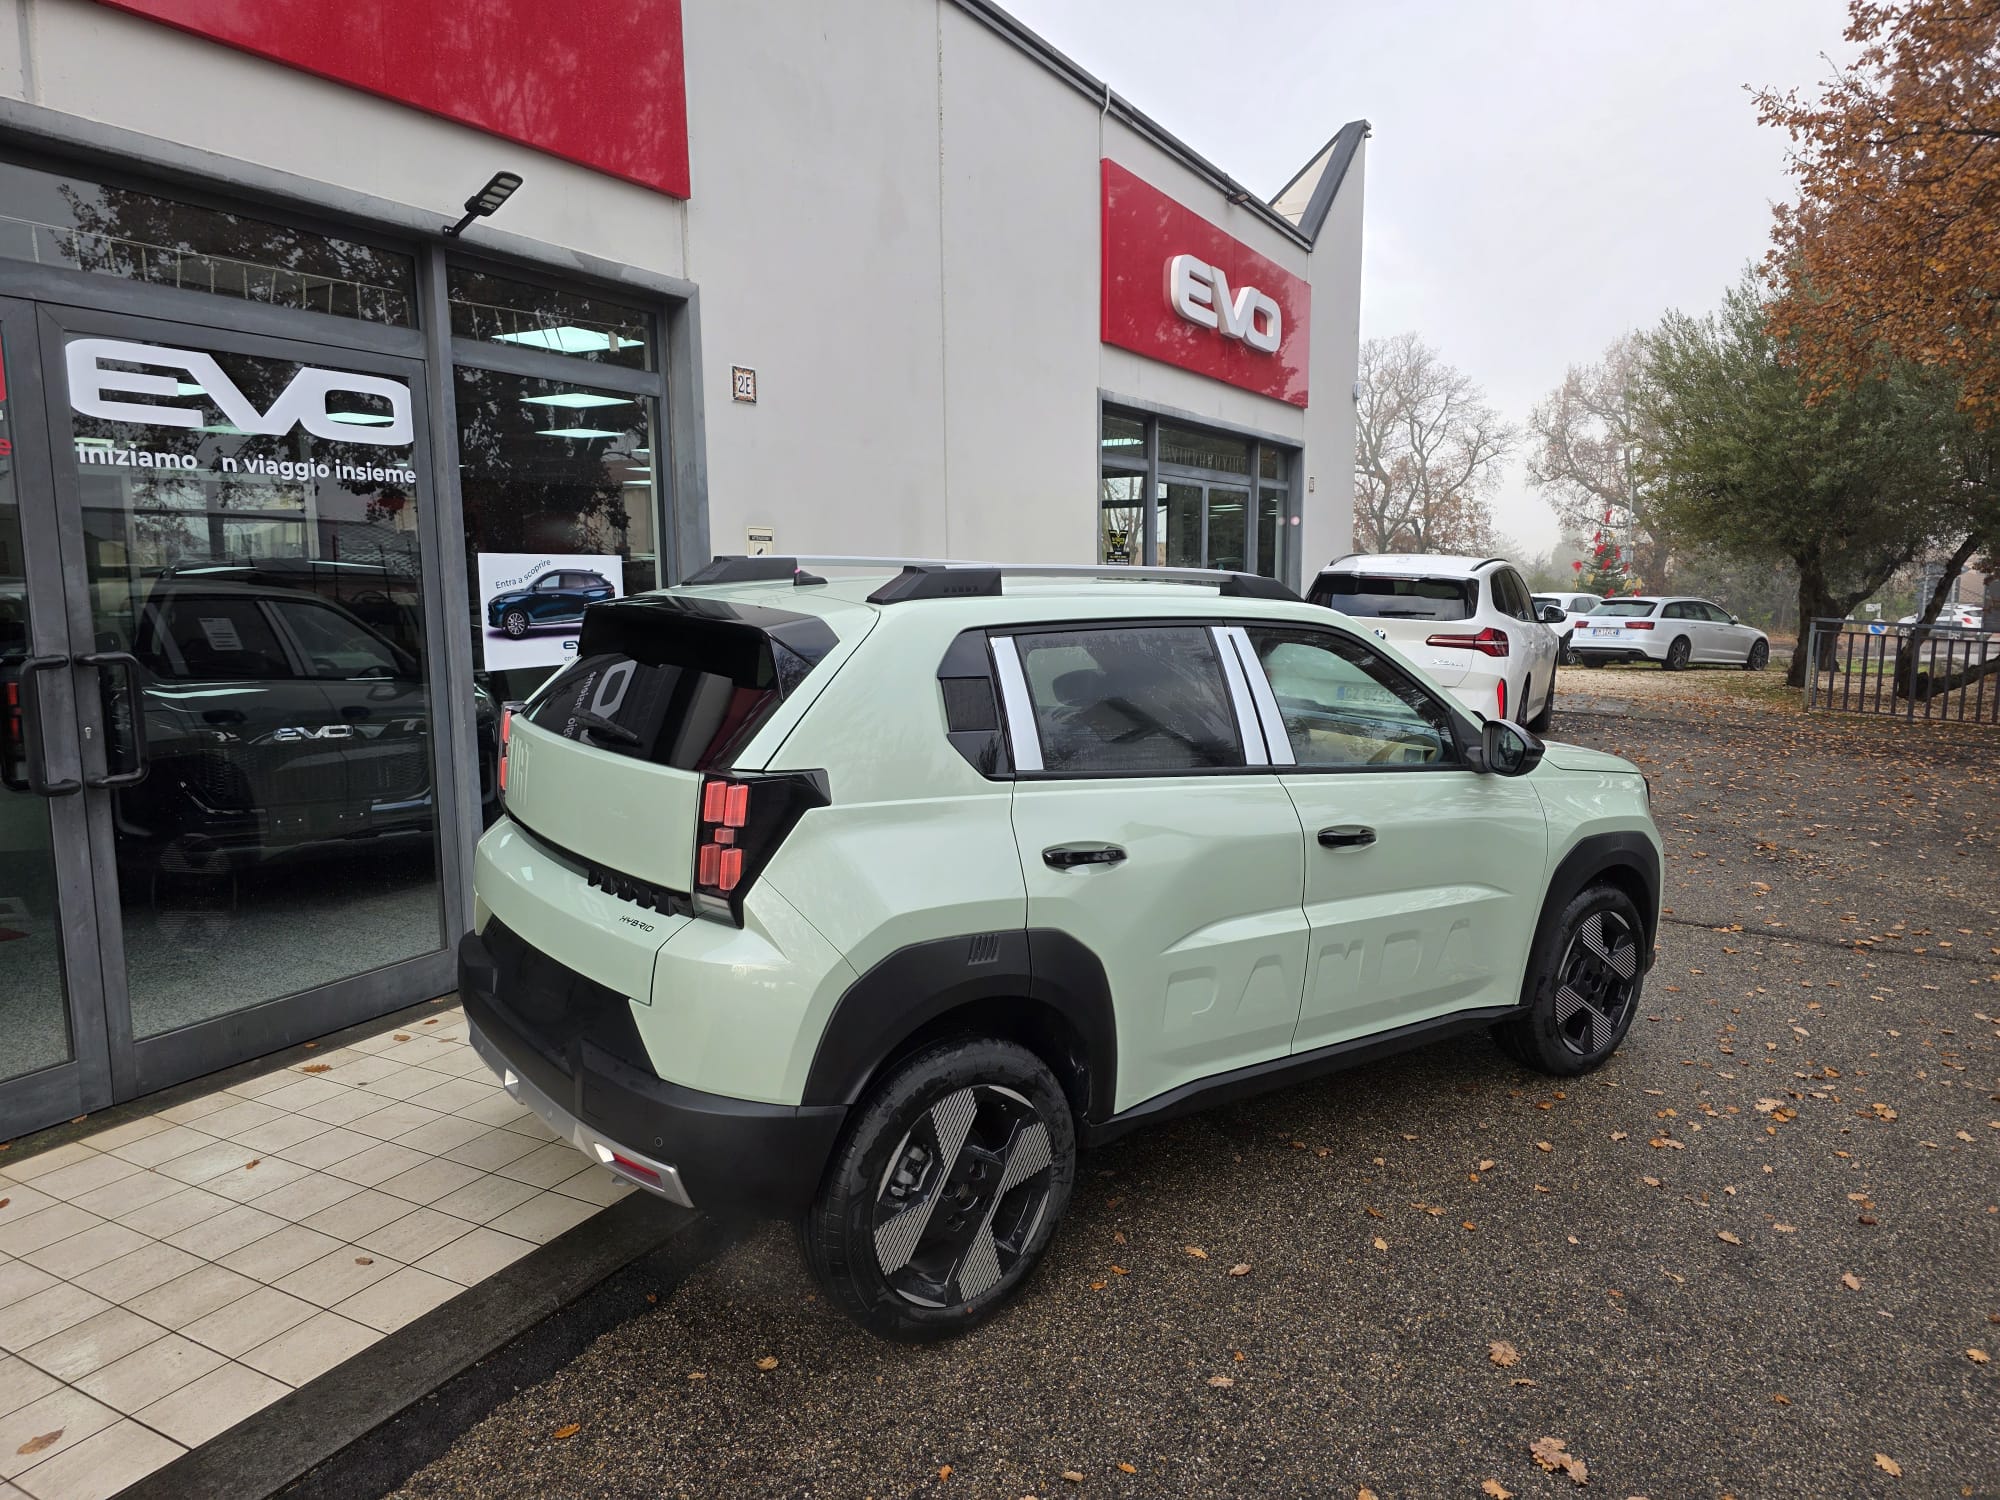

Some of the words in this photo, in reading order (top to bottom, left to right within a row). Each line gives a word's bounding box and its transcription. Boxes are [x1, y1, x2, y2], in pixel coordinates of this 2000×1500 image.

[1170, 254, 1281, 352] EVO
[65, 338, 414, 446] EVO
[737, 375, 751, 394] 2E
[79, 442, 198, 470] Iniziamo
[244, 453, 330, 481] viaggio
[335, 459, 417, 483] insieme
[495, 579, 516, 589] Entra
[523, 559, 551, 580] scoprire
[273, 725, 354, 741] EVO
[619, 914, 656, 934] HYBRID
